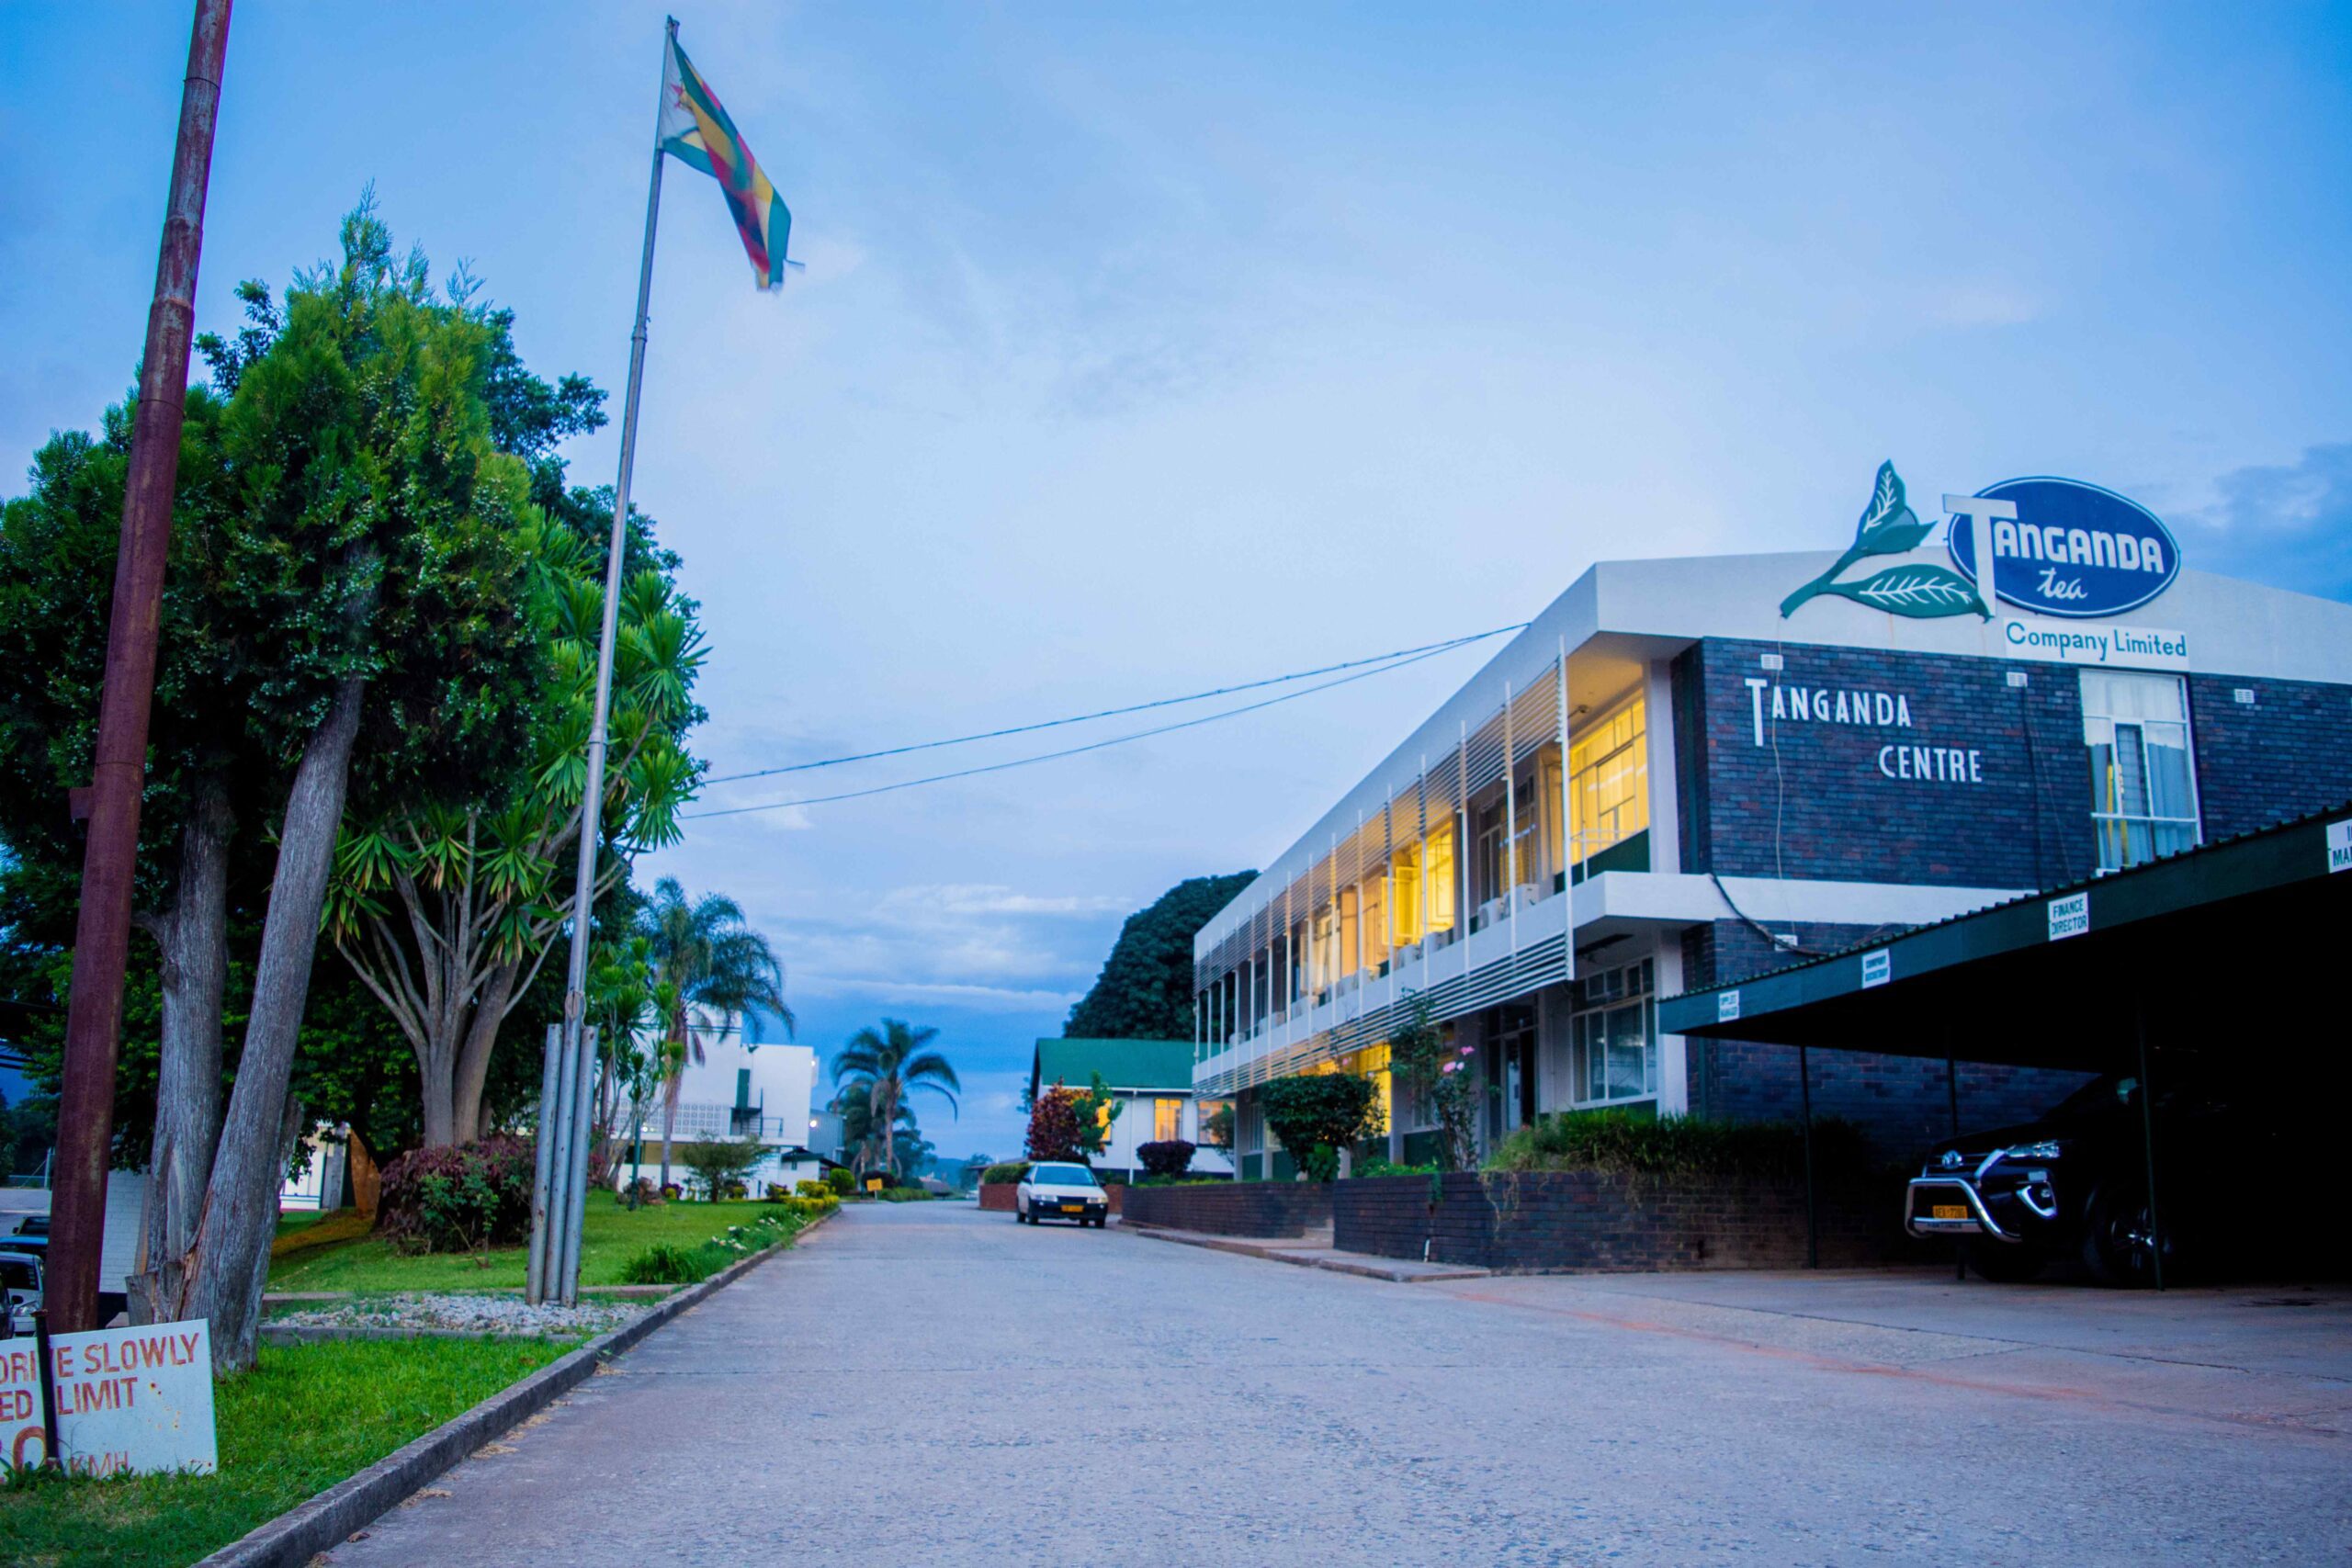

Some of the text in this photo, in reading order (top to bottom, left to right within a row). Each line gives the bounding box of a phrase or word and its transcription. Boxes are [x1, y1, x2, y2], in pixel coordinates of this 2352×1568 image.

[1942, 493, 2165, 617] TANGANDA
[2037, 567, 2088, 600] tea
[2006, 622, 2188, 661] Company Limited
[1745, 678, 1912, 747] TANGANDA
[1879, 746, 1983, 783] CENTRE
[2332, 846, 2352, 867] MA
[2051, 914, 2087, 935] DIRECTOR
[2052, 897, 2085, 919] FINANCE
[0, 1332, 199, 1384] RIE SLOWLY
[56, 1376, 139, 1416] LIMIT
